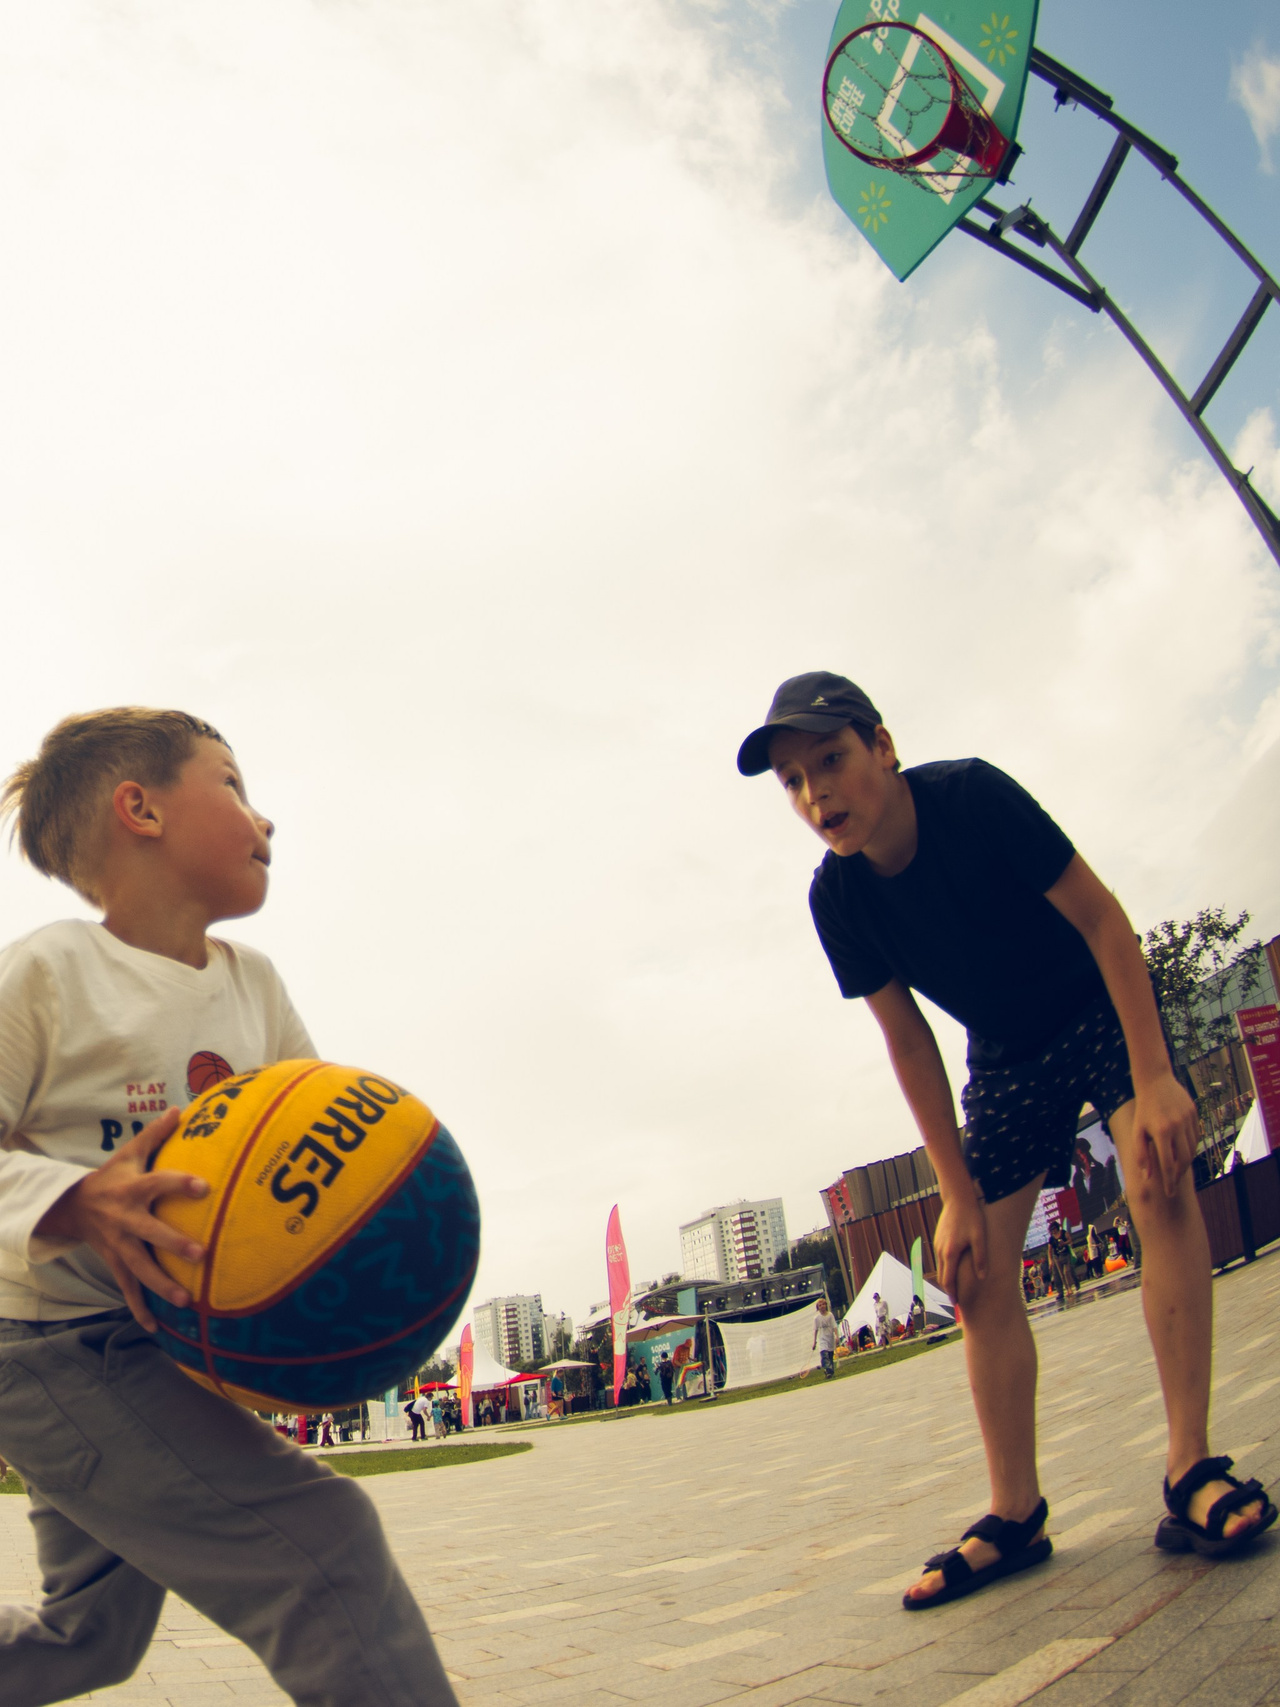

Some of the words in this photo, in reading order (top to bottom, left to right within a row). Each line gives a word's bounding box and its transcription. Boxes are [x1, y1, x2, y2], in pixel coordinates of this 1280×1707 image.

[839, 86, 865, 134] COFFEE
[126, 1082, 166, 1096] PLAY
[128, 1100, 167, 1113] HARD
[255, 1141, 290, 1187] OUTDOOR
[271, 1076, 411, 1218] ORRES
